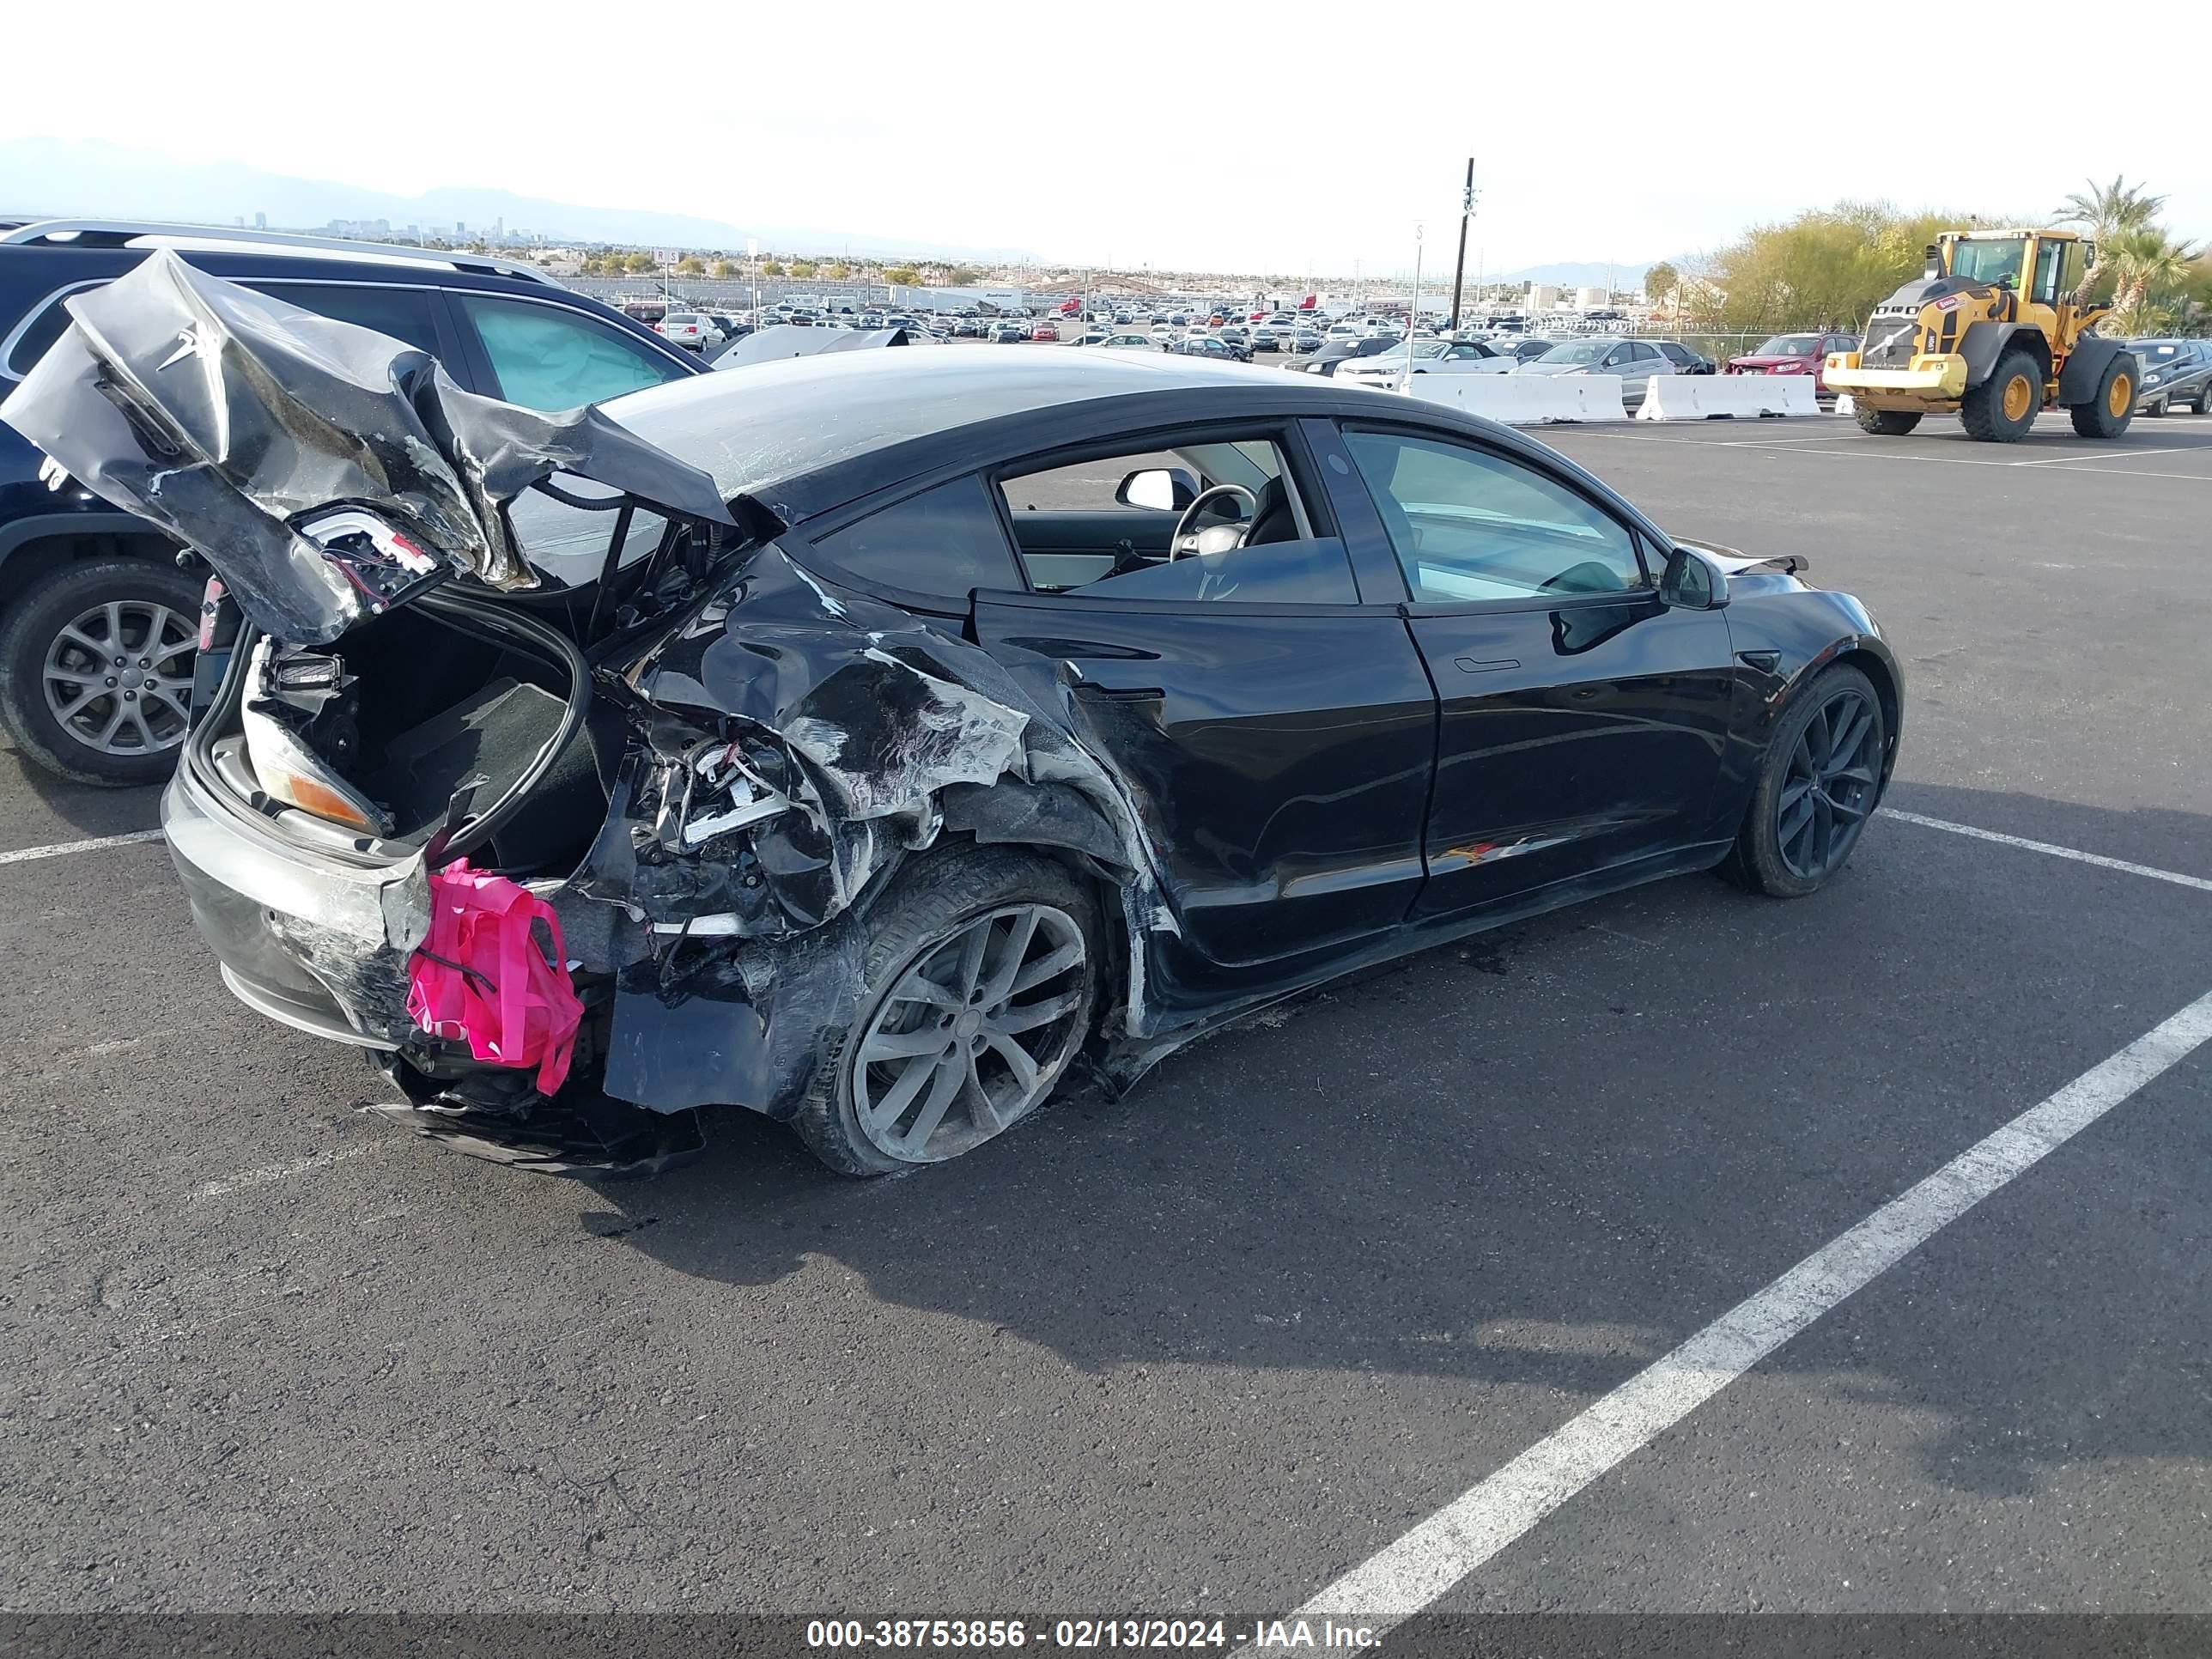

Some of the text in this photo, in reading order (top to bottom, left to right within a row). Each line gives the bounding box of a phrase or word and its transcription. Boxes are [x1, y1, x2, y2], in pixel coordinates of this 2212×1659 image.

[1416, 224, 1423, 240] S
[658, 251, 664, 260] R
[671, 252, 676, 262] S
